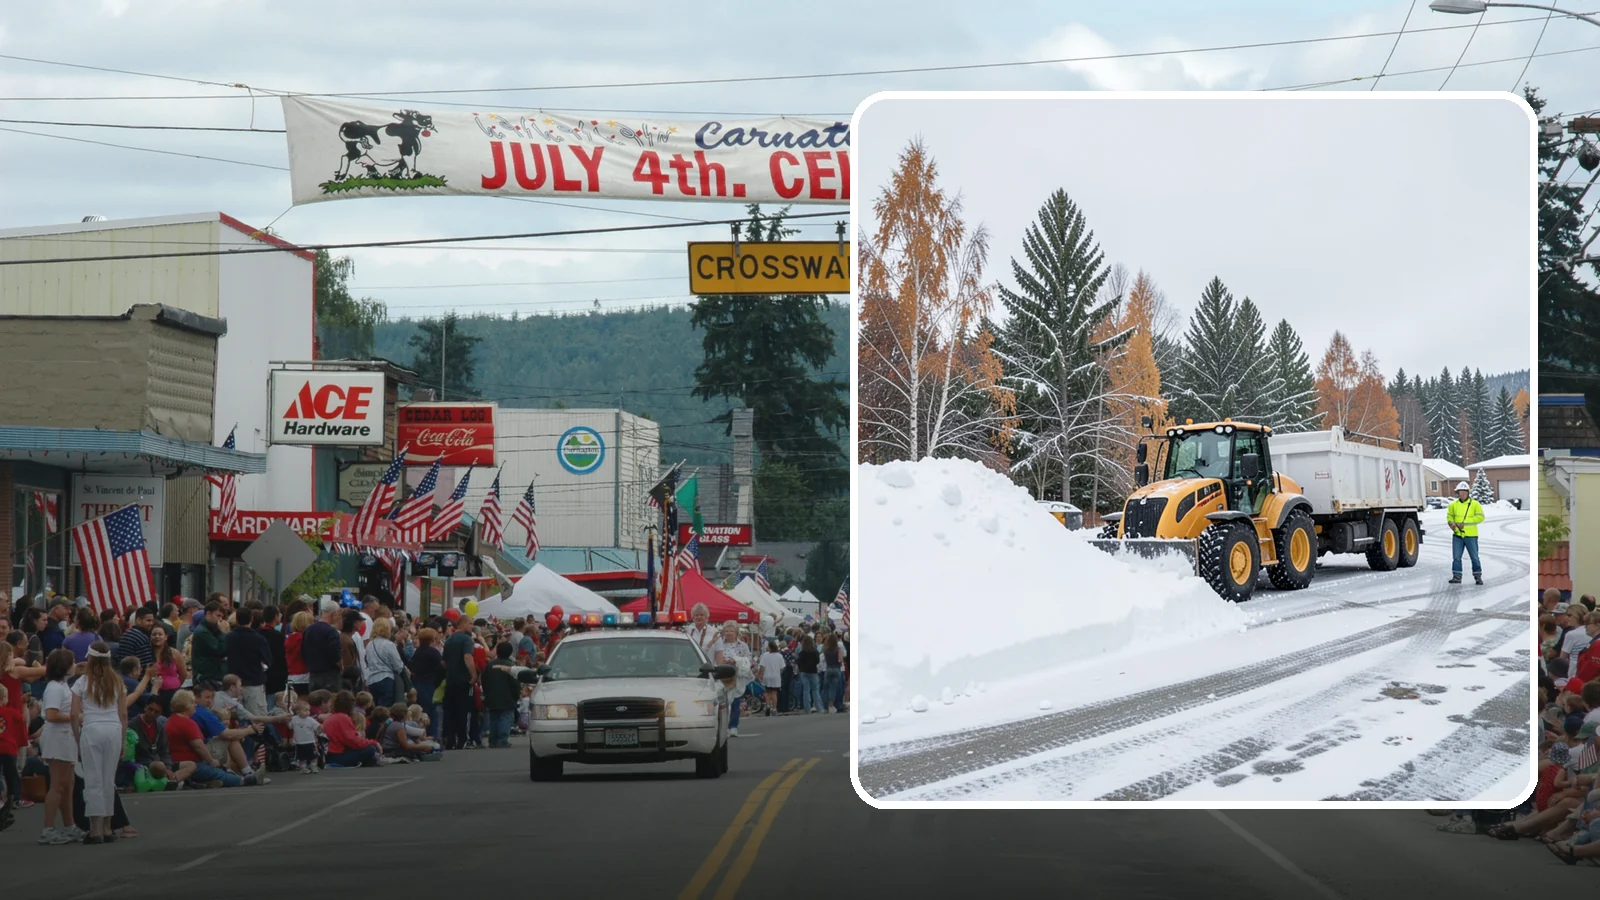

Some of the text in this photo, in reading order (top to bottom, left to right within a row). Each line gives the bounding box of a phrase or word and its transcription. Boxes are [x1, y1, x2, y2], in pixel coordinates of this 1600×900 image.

[694, 121, 850, 150] Carnat
[481, 140, 605, 193] JULY
[632, 149, 747, 198] 4th.
[696, 254, 850, 280] CROSSWA
[283, 380, 374, 420] ACE
[406, 409, 486, 422] CEDAR LOG
[283, 421, 371, 437] Hardware
[416, 428, 477, 447] Coca-Cola
[353, 467, 385, 480] Simpl
[96, 485, 125, 494] Vincent
[126, 486, 136, 494] de
[138, 486, 155, 495] Paul
[81, 503, 154, 522] THRT
[688, 526, 742, 535] CRNATION
[699, 535, 730, 543] GLASS
